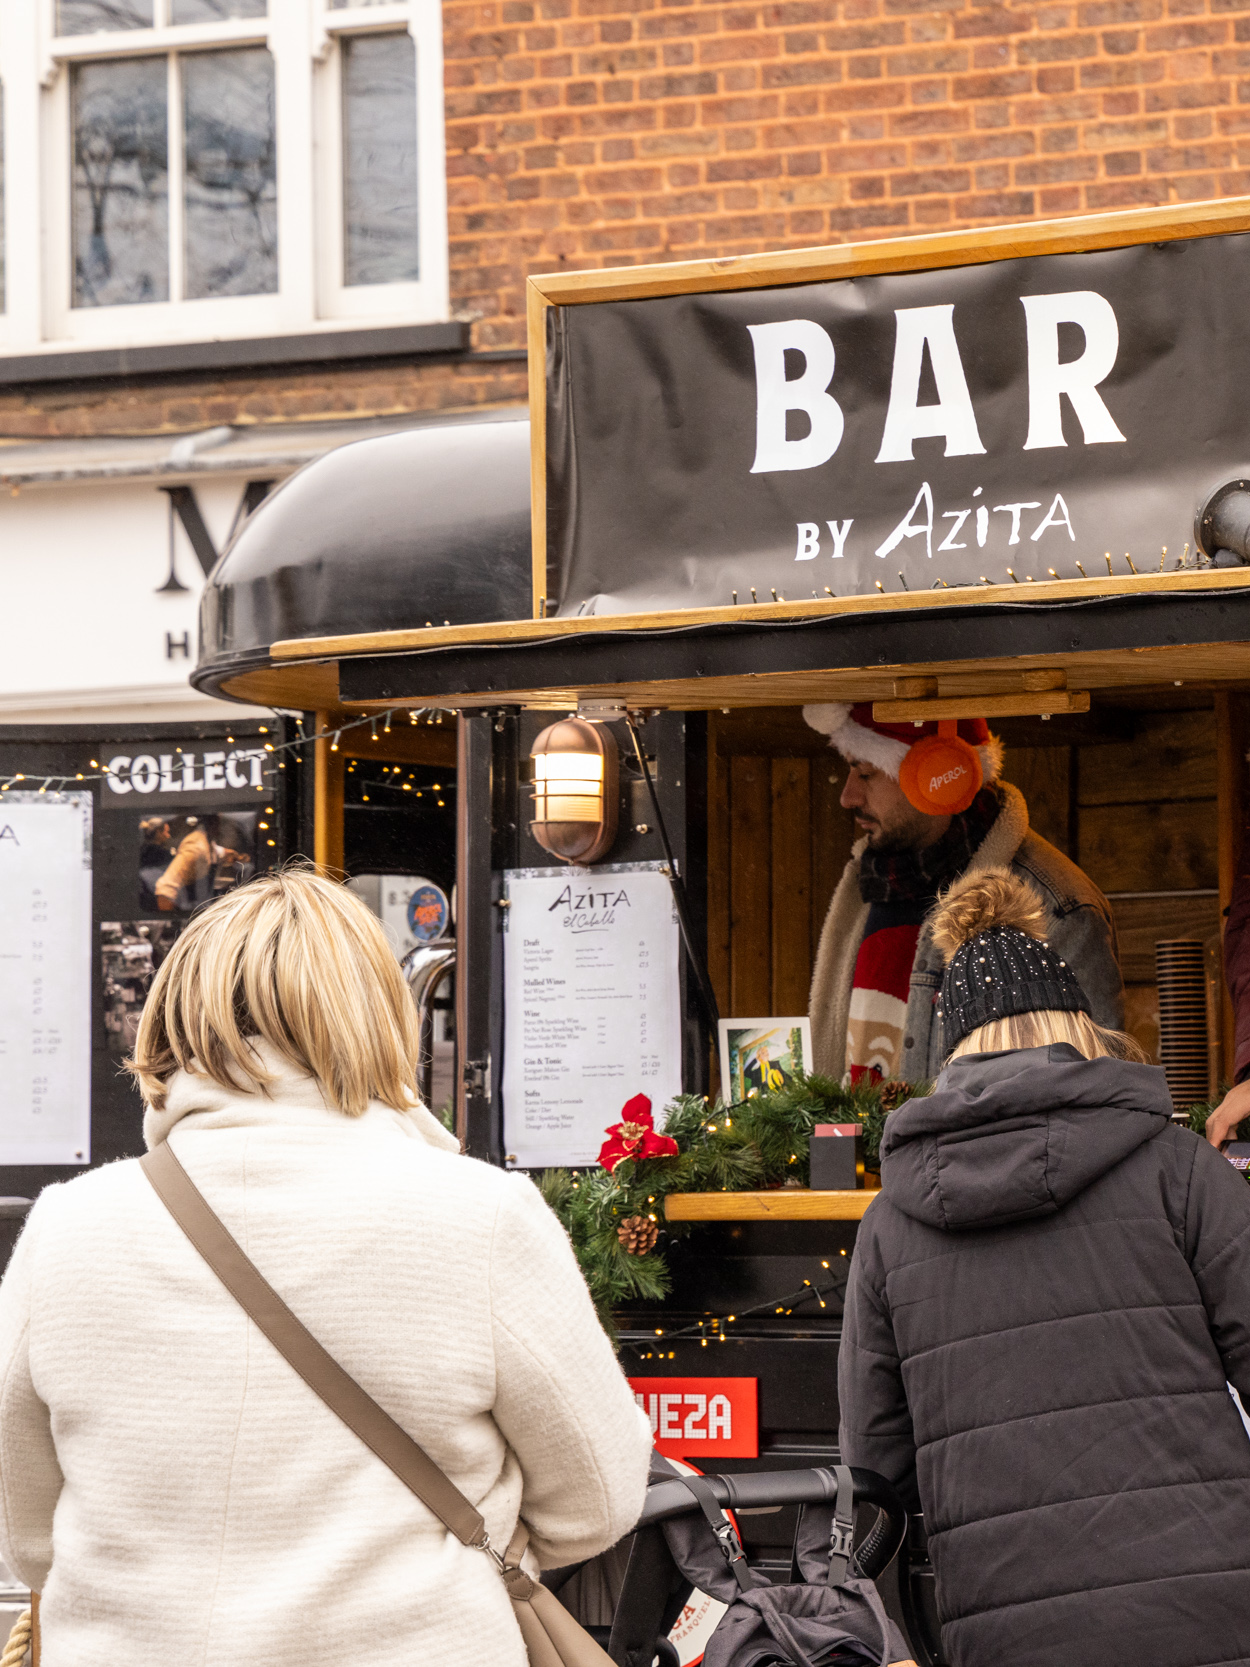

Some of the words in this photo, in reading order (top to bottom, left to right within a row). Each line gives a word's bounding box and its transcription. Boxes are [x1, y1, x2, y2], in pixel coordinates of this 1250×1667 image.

[746, 290, 1127, 473] BAR
[794, 519, 854, 560] BY
[107, 750, 267, 794] COLLECT
[929, 765, 967, 792] APEROL
